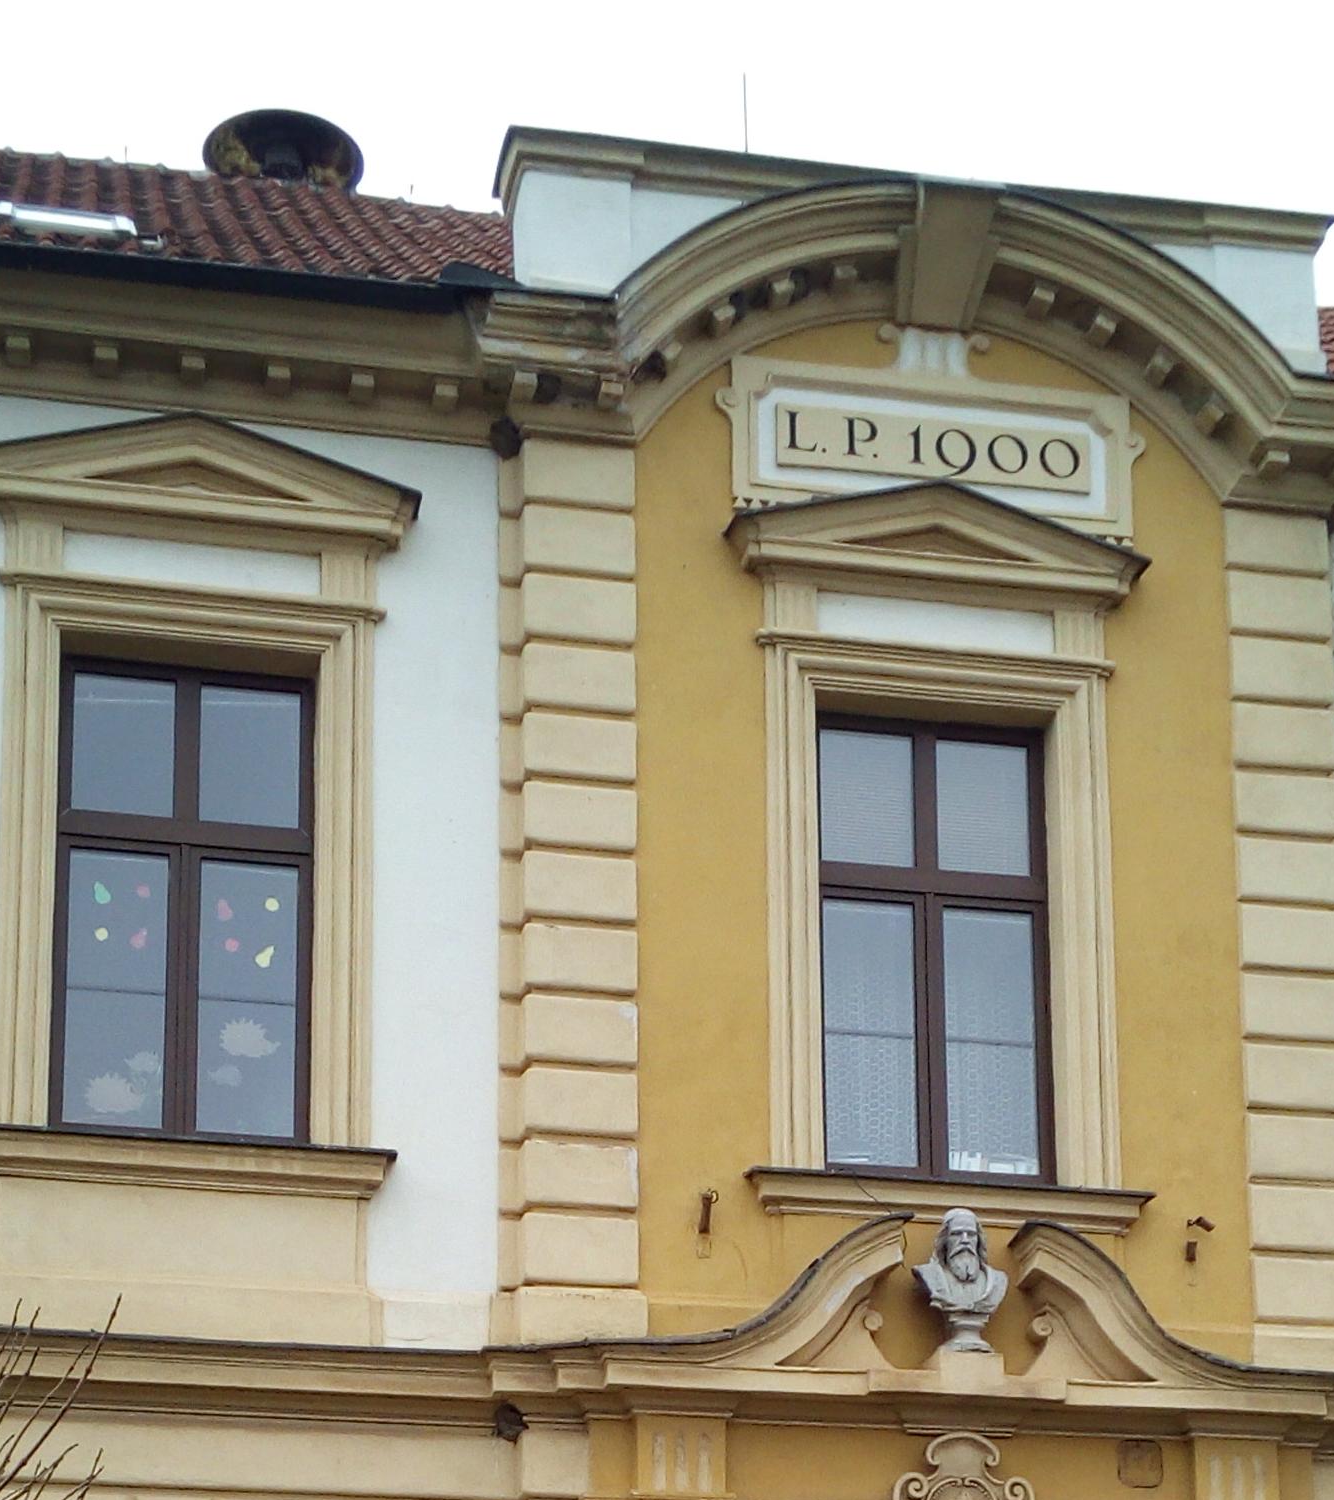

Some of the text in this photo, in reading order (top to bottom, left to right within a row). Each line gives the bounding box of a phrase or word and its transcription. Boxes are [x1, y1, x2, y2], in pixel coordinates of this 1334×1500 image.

[785, 410, 1081, 478] L. P. 1900
